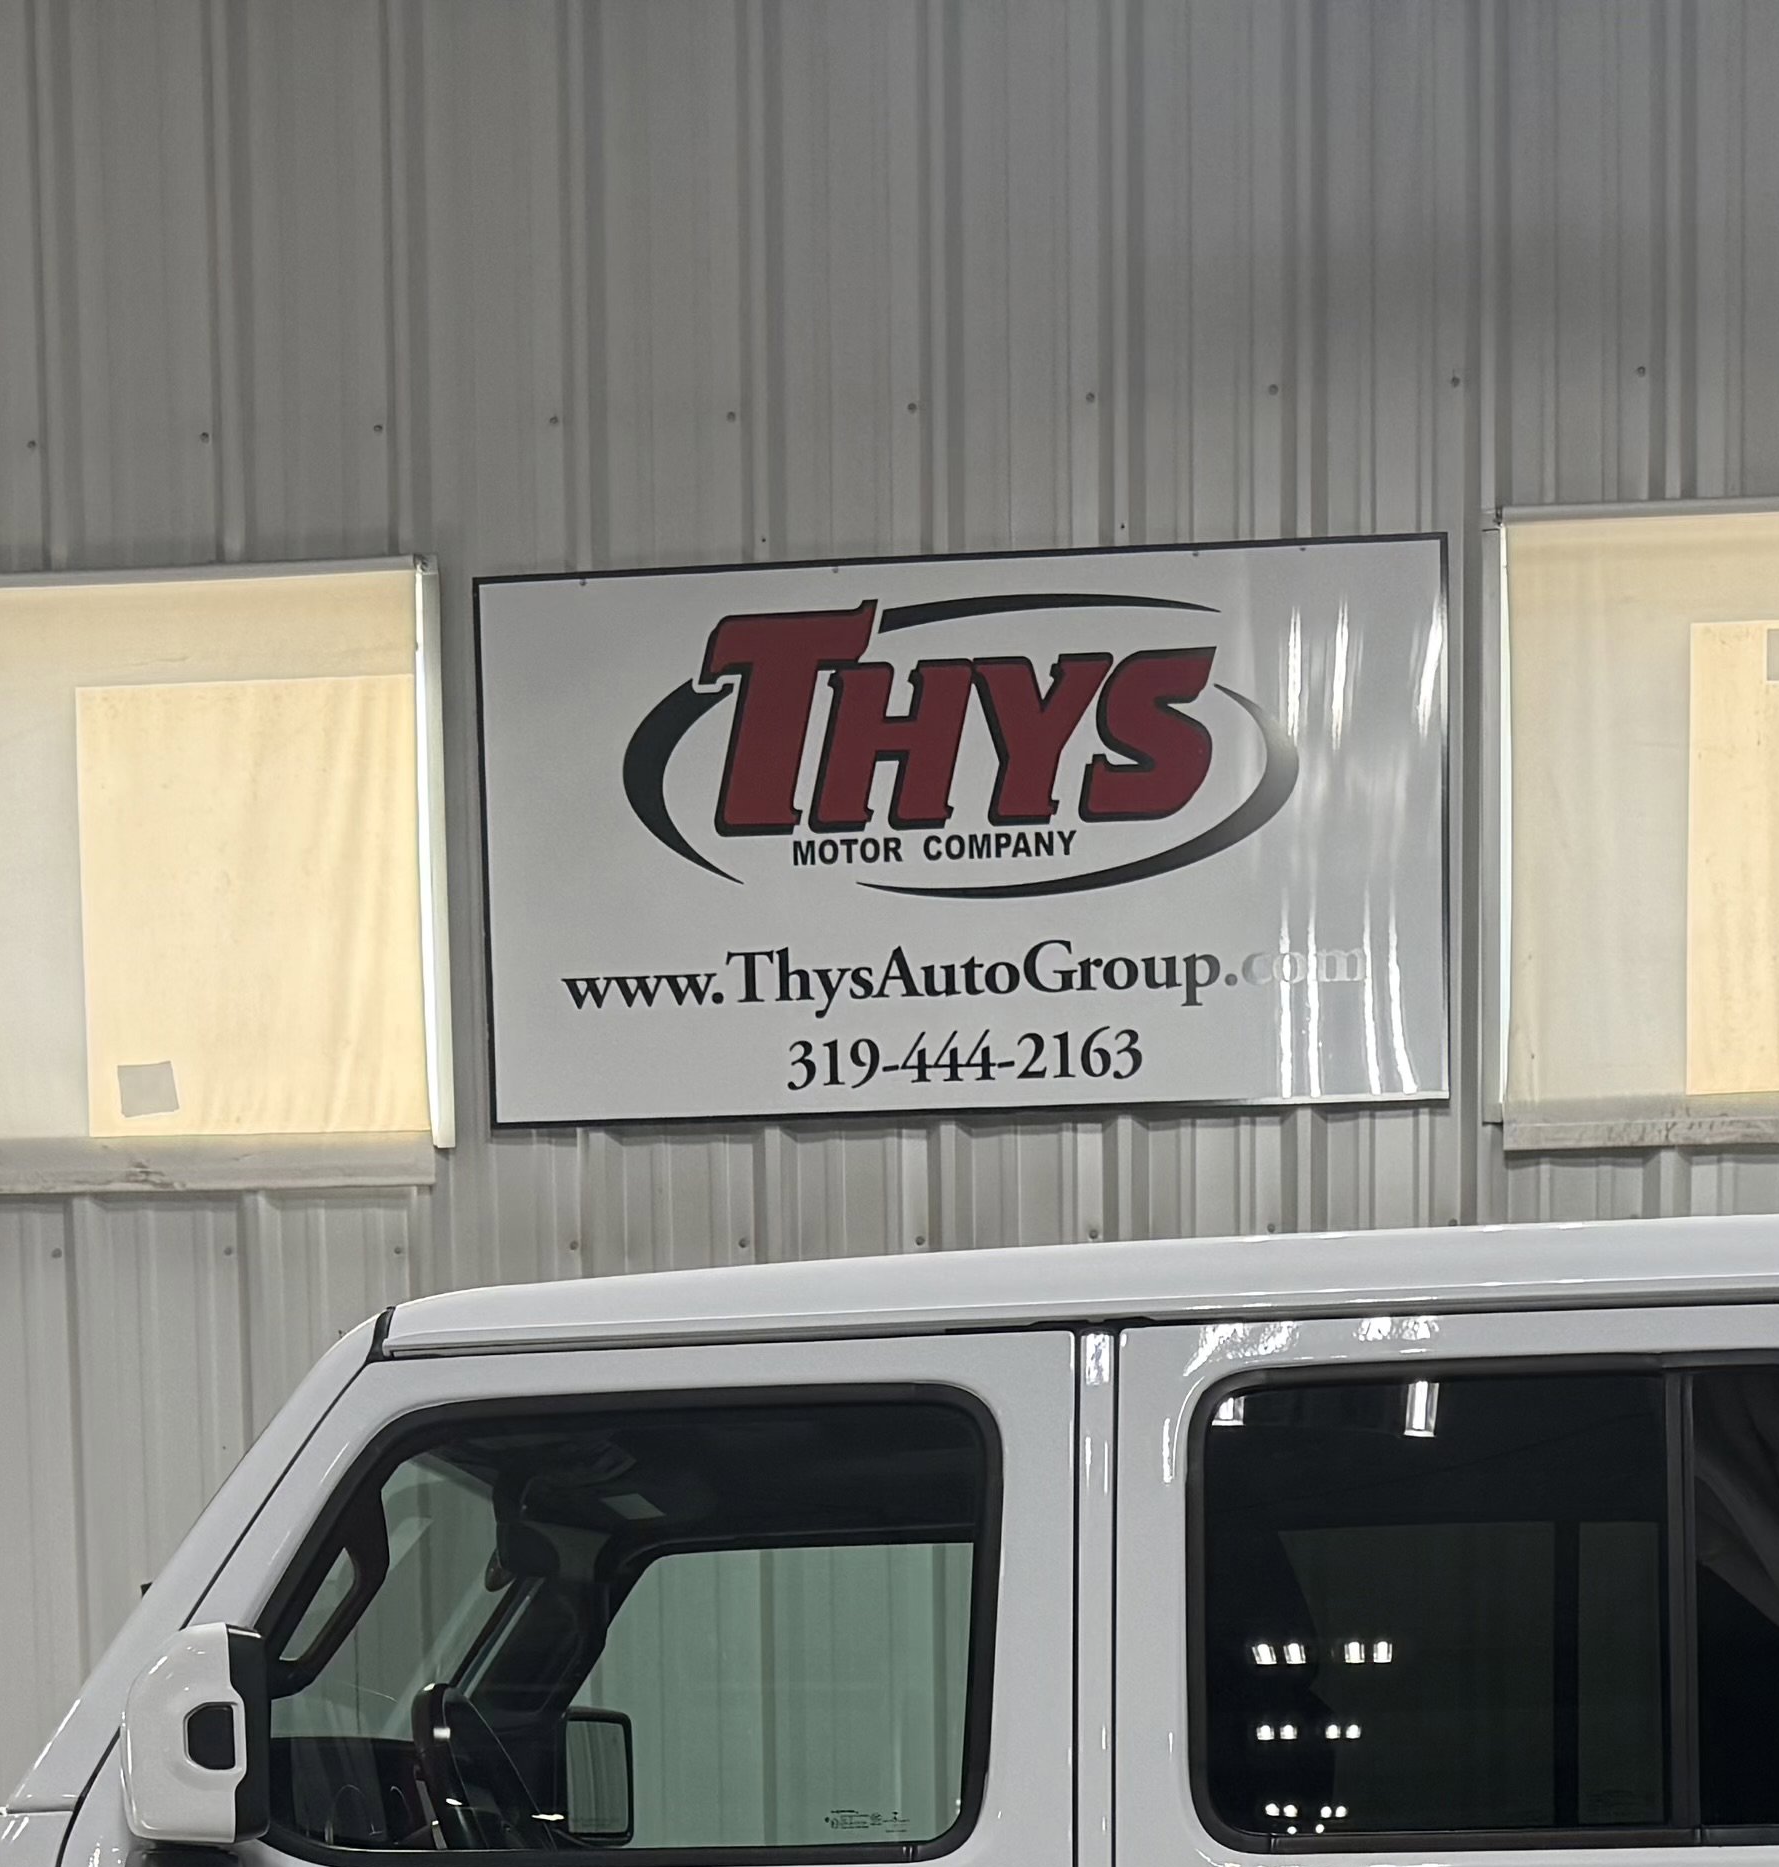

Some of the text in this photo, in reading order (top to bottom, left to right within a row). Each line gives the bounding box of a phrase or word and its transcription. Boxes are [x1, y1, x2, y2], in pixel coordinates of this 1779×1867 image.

[693, 599, 1217, 838] THYS
[791, 829, 1078, 868] MOTOR COMPANY
[787, 1026, 1143, 1091] 319-444-2163
